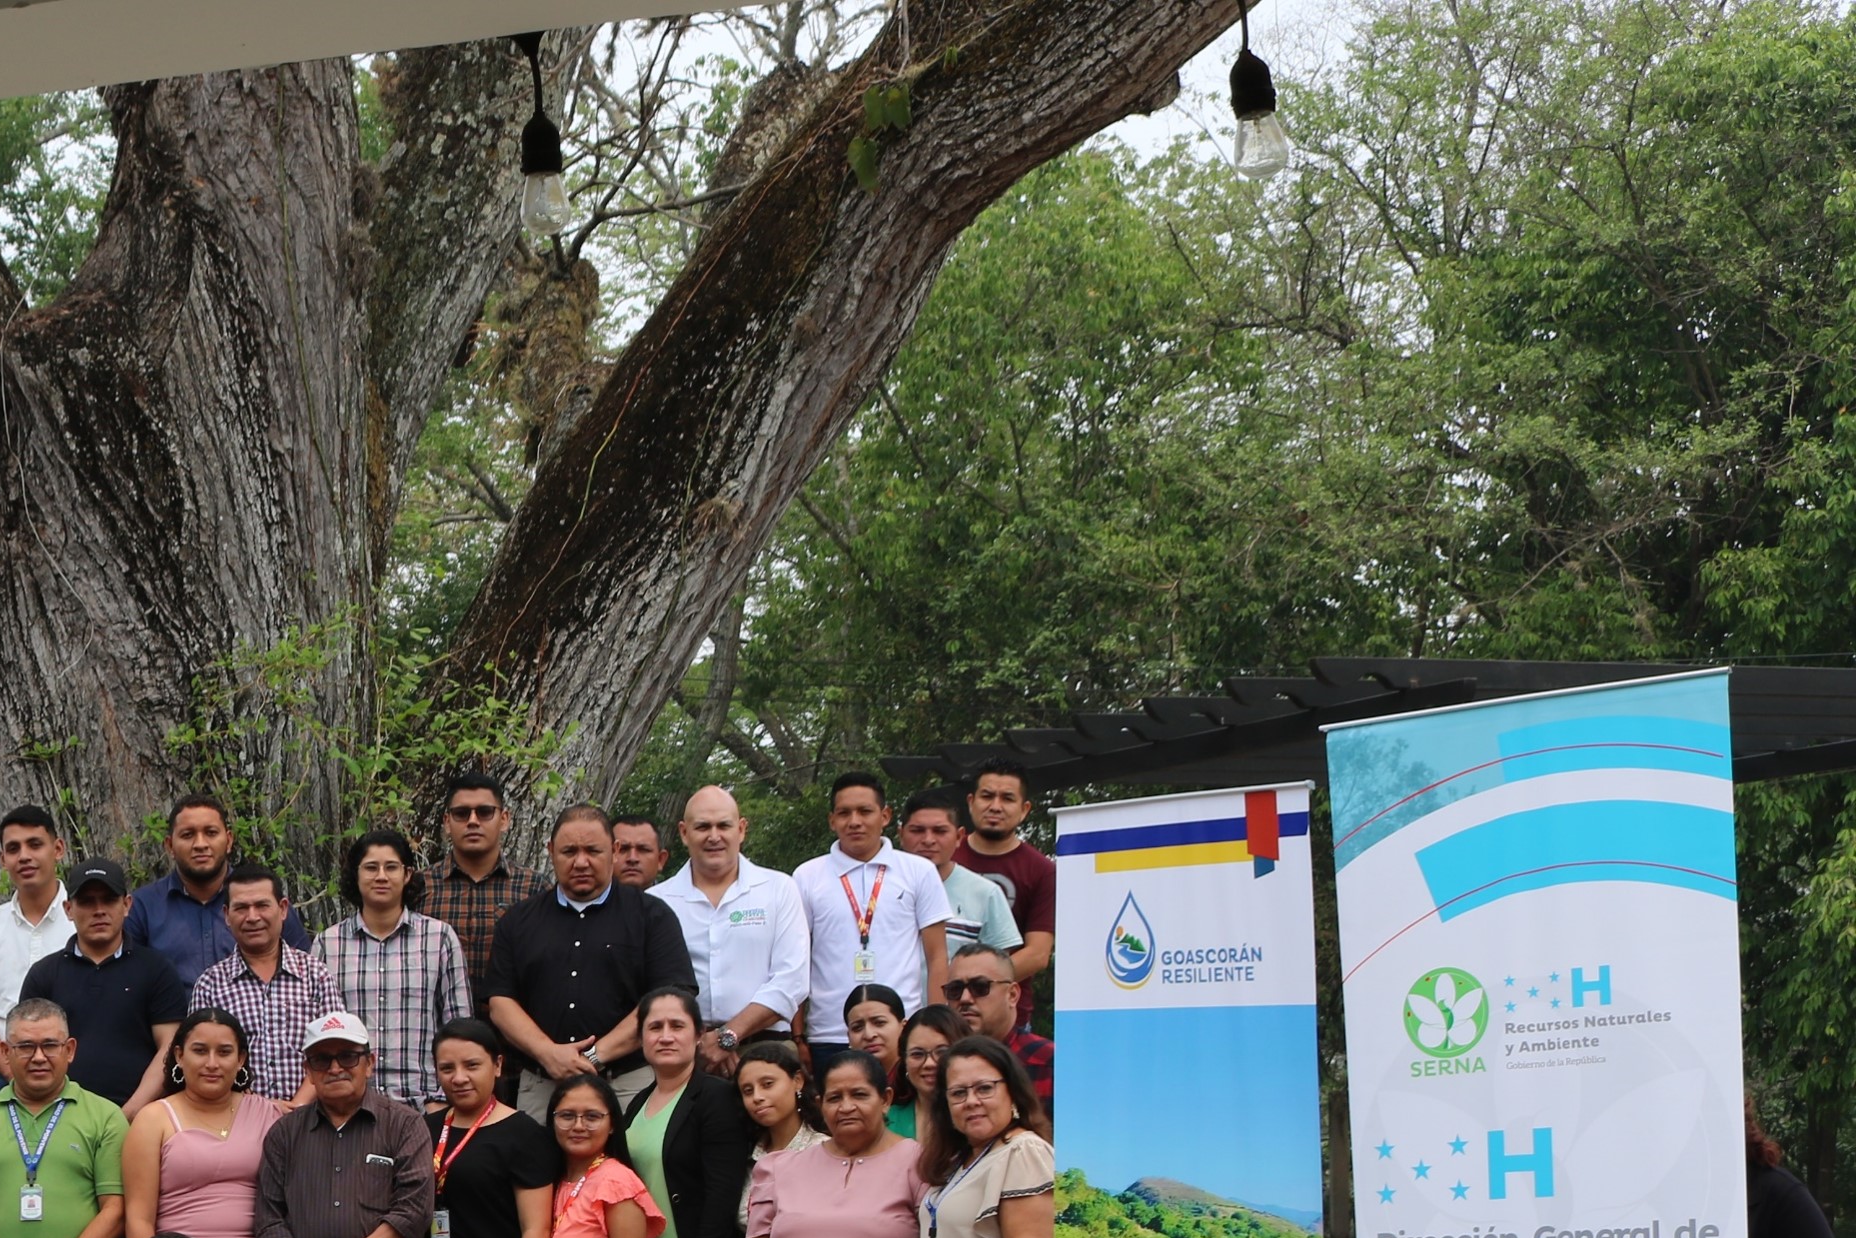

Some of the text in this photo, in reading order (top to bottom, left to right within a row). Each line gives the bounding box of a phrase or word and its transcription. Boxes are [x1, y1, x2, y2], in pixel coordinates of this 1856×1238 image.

[1161, 943, 1263, 965] GOASCORÁN
[1162, 966, 1255, 984] RESILIENTE
[1571, 965, 1612, 1008] H
[1505, 1010, 1672, 1034] Recursos Naturales
[1505, 1037, 1600, 1056] y Ambiente
[1410, 1057, 1487, 1078] SERNA
[1506, 1056, 1606, 1070] Gobierno de la República
[1487, 1127, 1554, 1200] H
